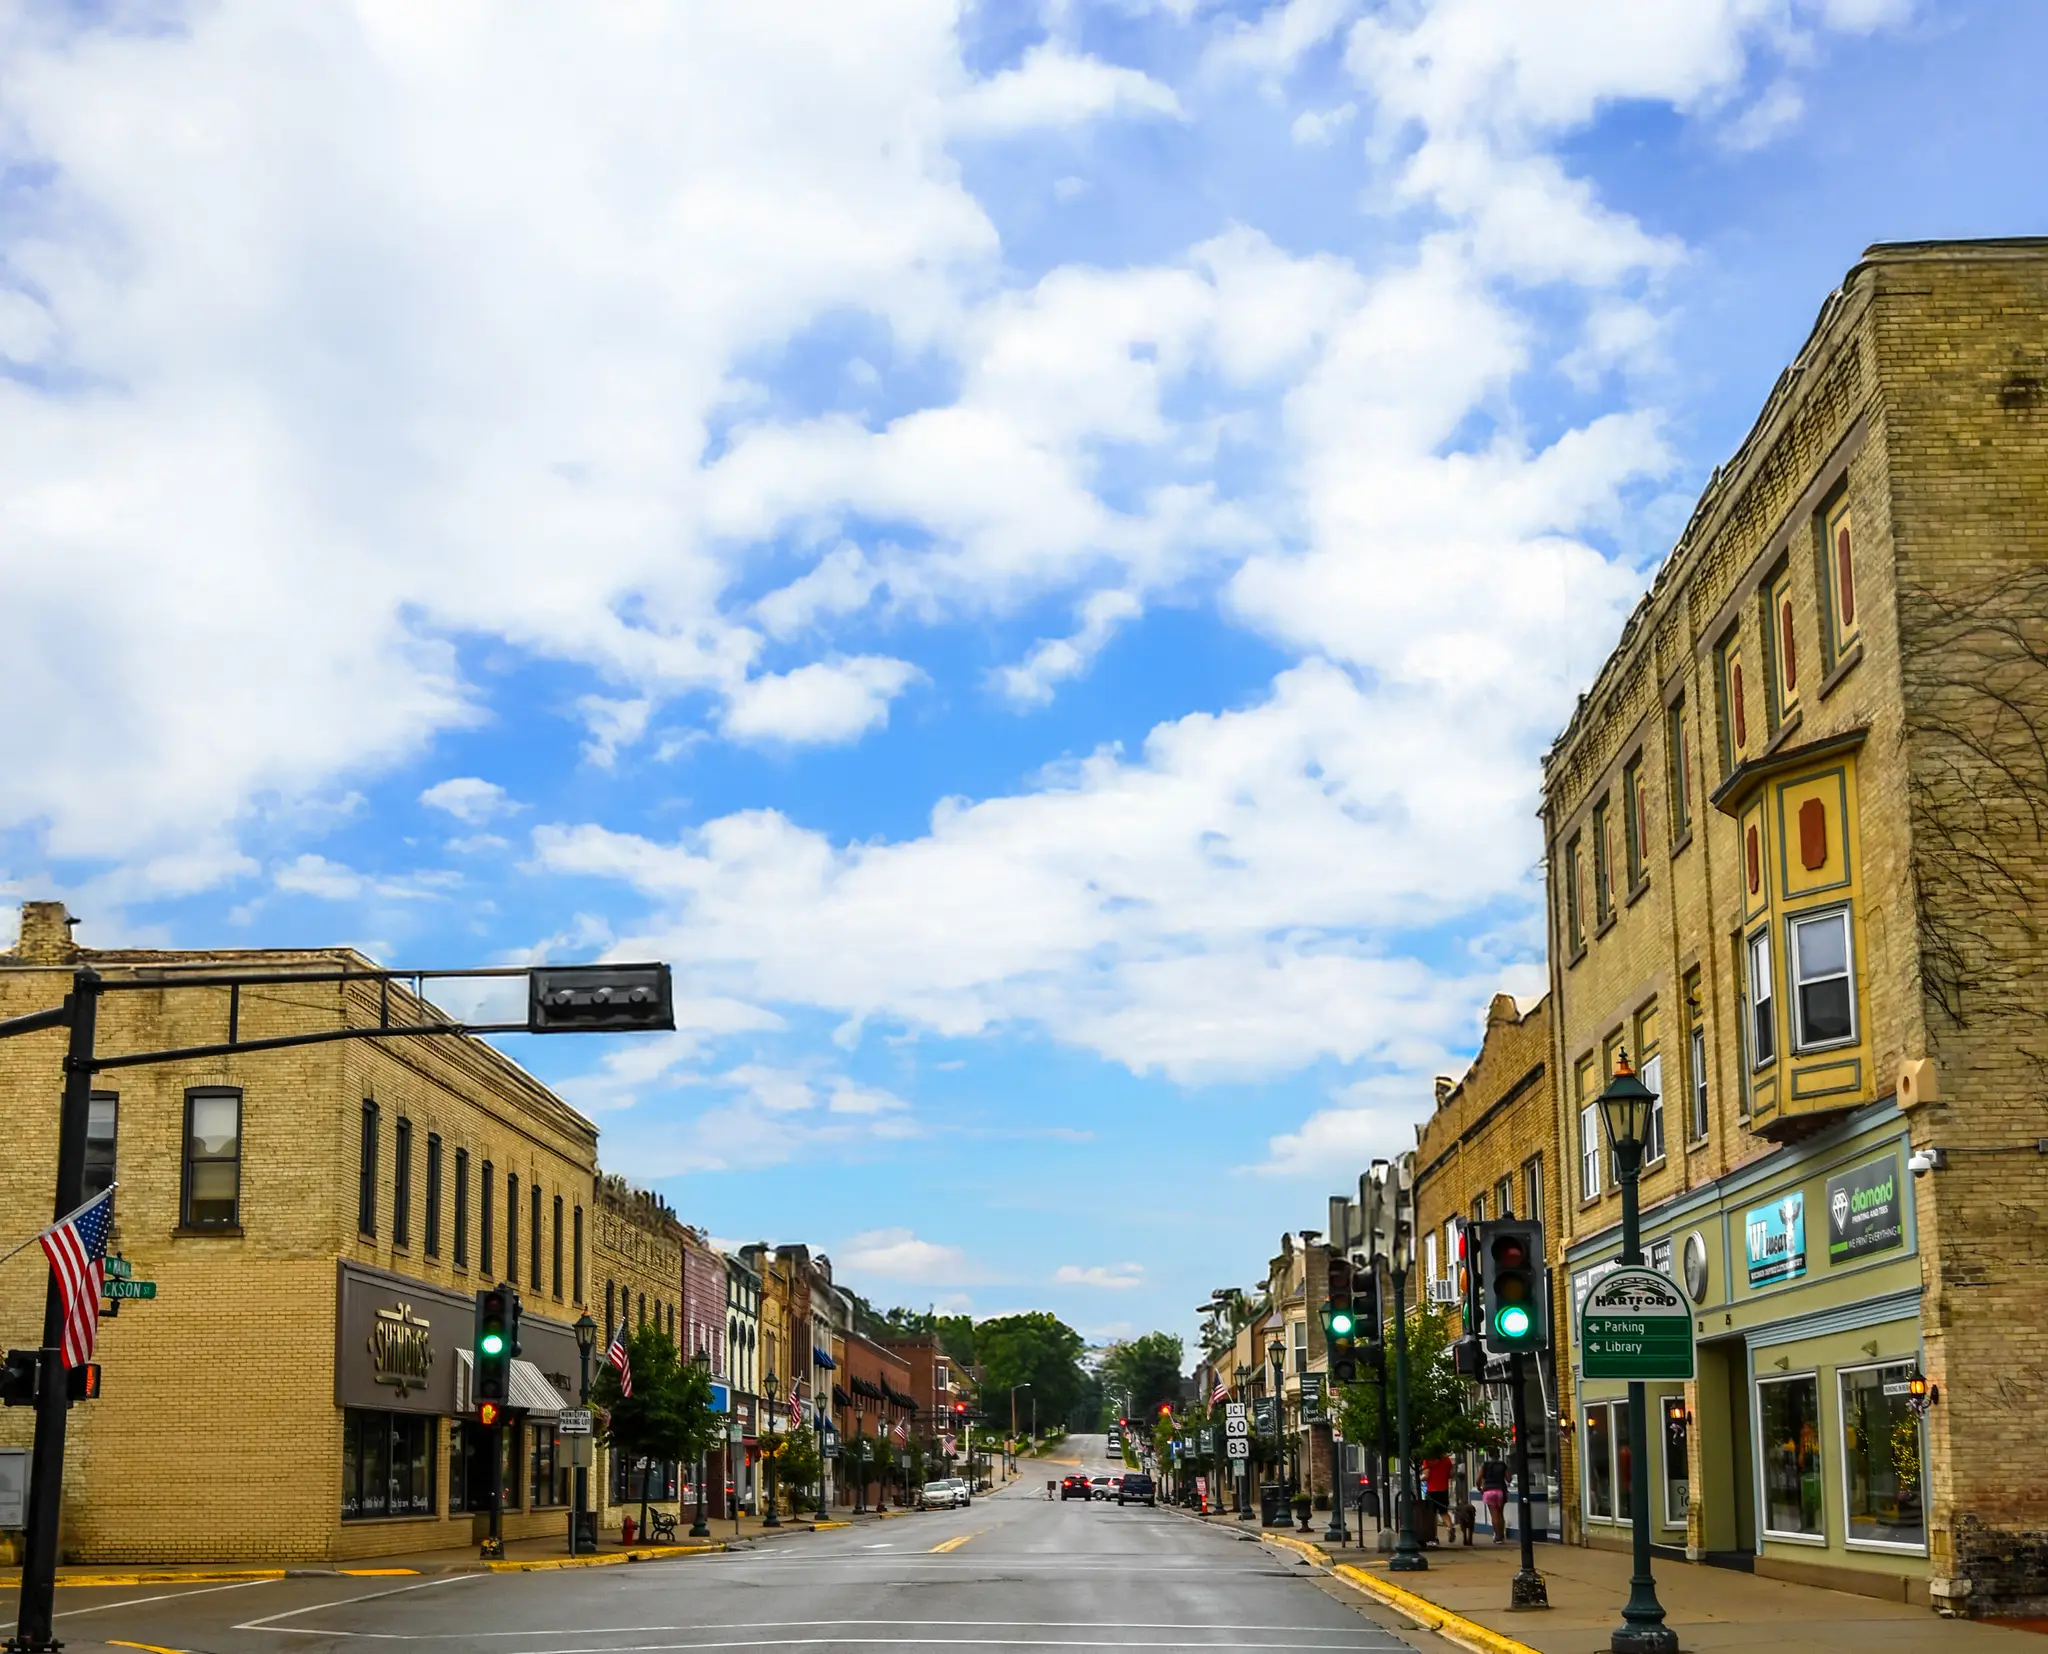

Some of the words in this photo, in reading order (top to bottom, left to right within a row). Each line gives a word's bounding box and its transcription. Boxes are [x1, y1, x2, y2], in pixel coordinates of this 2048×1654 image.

[1851, 1174, 1893, 1213] diamond
[1595, 1295, 1677, 1307] HARTFORD
[1604, 1321, 1645, 1335] Parking
[1605, 1341, 1643, 1354] Library
[1228, 1405, 1244, 1415] JCT
[560, 1418, 580, 1426] PARKING
[1228, 1420, 1246, 1433] 60
[1229, 1442, 1247, 1455] 83
